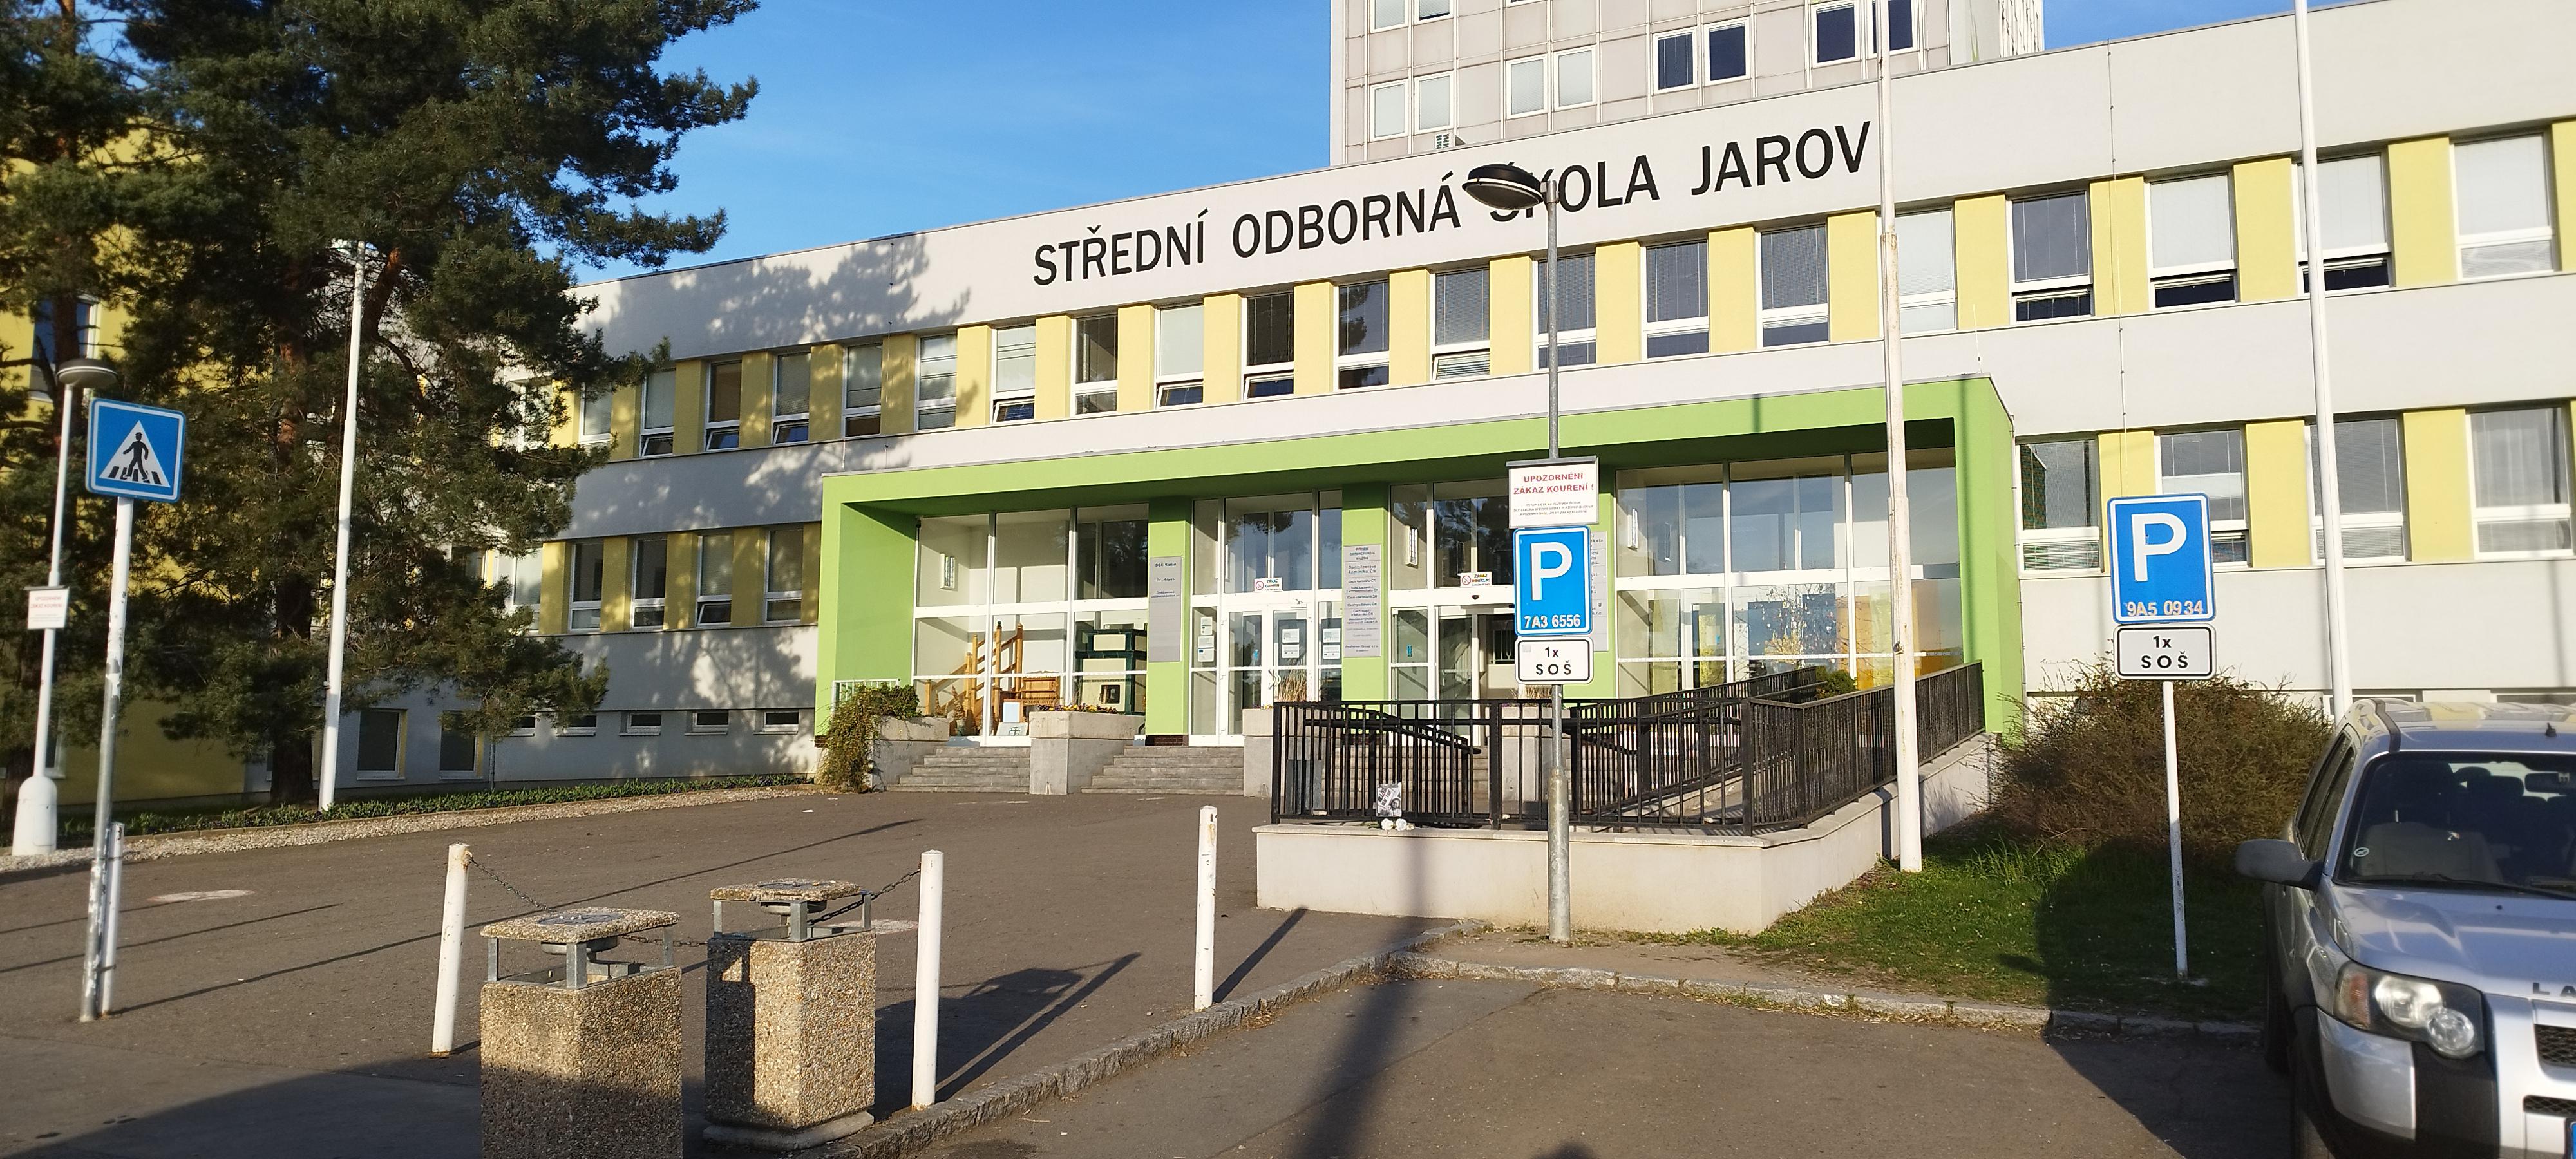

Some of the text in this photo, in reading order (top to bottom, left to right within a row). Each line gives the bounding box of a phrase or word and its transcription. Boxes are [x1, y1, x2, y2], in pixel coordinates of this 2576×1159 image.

[1034, 207, 1209, 286] STŘEDNÍ
[1231, 170, 1461, 258] ODBORNÁ
[1690, 120, 1870, 196] JAROV
[1513, 485, 1544, 495] ZÁKAZ
[1546, 482, 1588, 493] KOUŘENÍ
[2131, 513, 2187, 582] P
[1530, 542, 1573, 601] P
[2127, 599, 2203, 616] 9A5 0934
[1524, 614, 1581, 628] 7A3 6556
[2153, 635, 2172, 648] 1x
[1545, 646, 1559, 657] 1x
